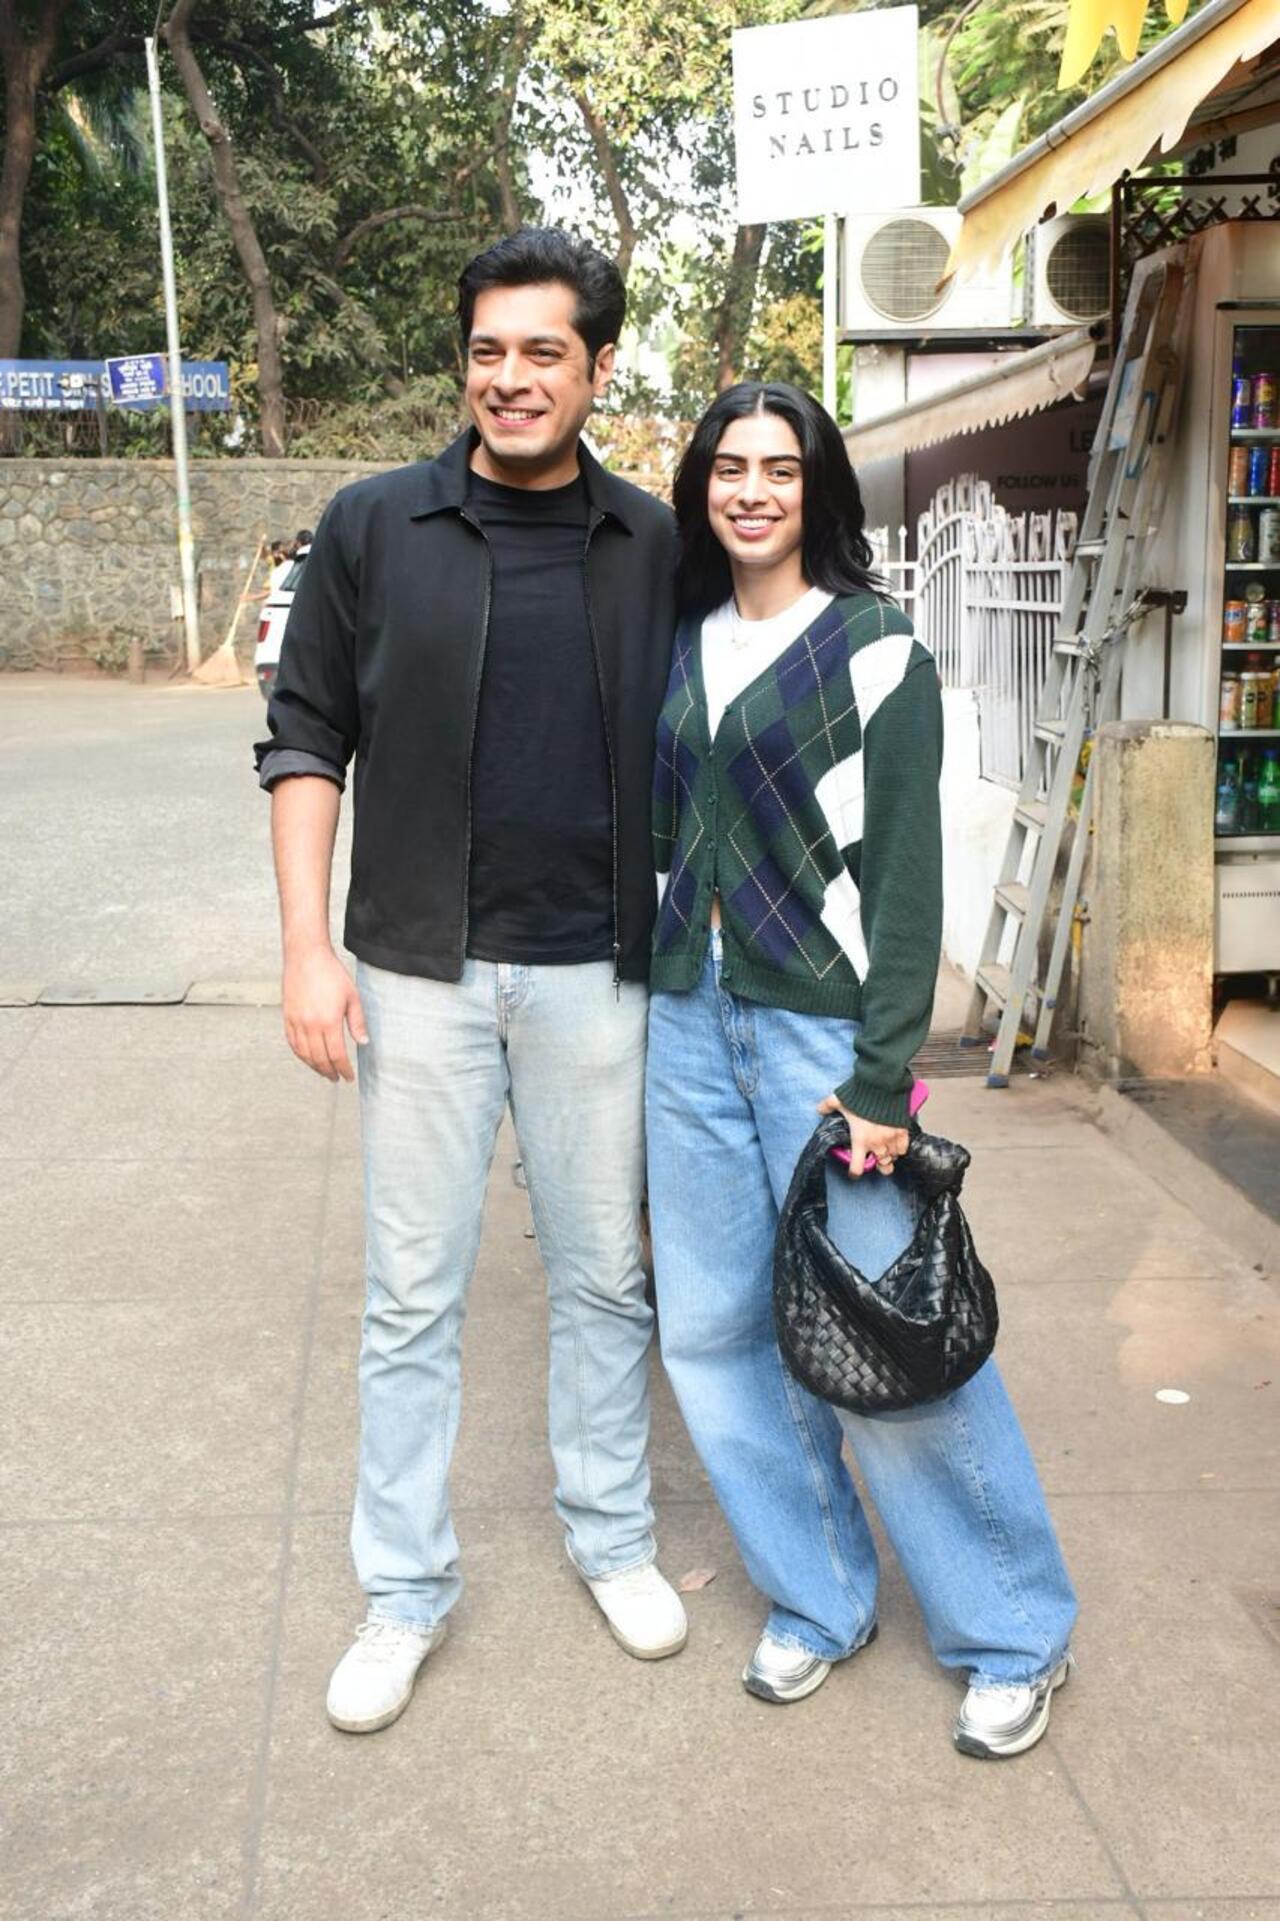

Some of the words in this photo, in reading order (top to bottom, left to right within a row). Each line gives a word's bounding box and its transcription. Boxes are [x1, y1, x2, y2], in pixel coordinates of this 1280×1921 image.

[752, 77, 899, 119] STUDIO
[769, 122, 884, 159] NAILS
[8, 372, 54, 397] PETIT
[996, 474, 1057, 489] FOLLOW
[1060, 474, 1080, 488] US
